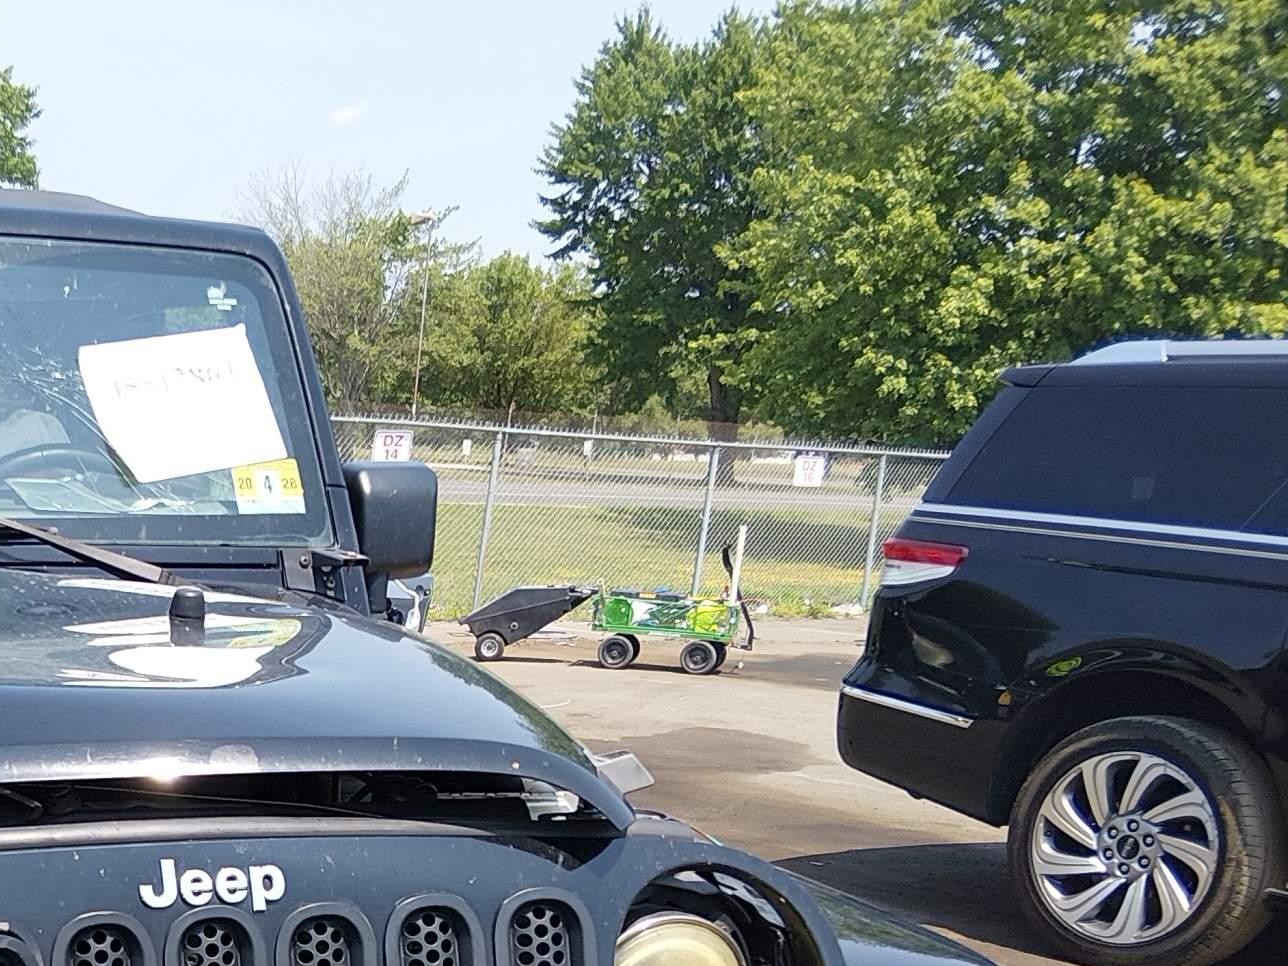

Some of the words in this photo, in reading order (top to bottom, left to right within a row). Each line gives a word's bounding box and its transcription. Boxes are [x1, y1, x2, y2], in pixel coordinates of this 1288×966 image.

[383, 434, 404, 447] DZ
[384, 448, 399, 461] 14
[238, 477, 253, 490] 20
[263, 474, 272, 494] 4
[138, 857, 286, 913] Jeep
